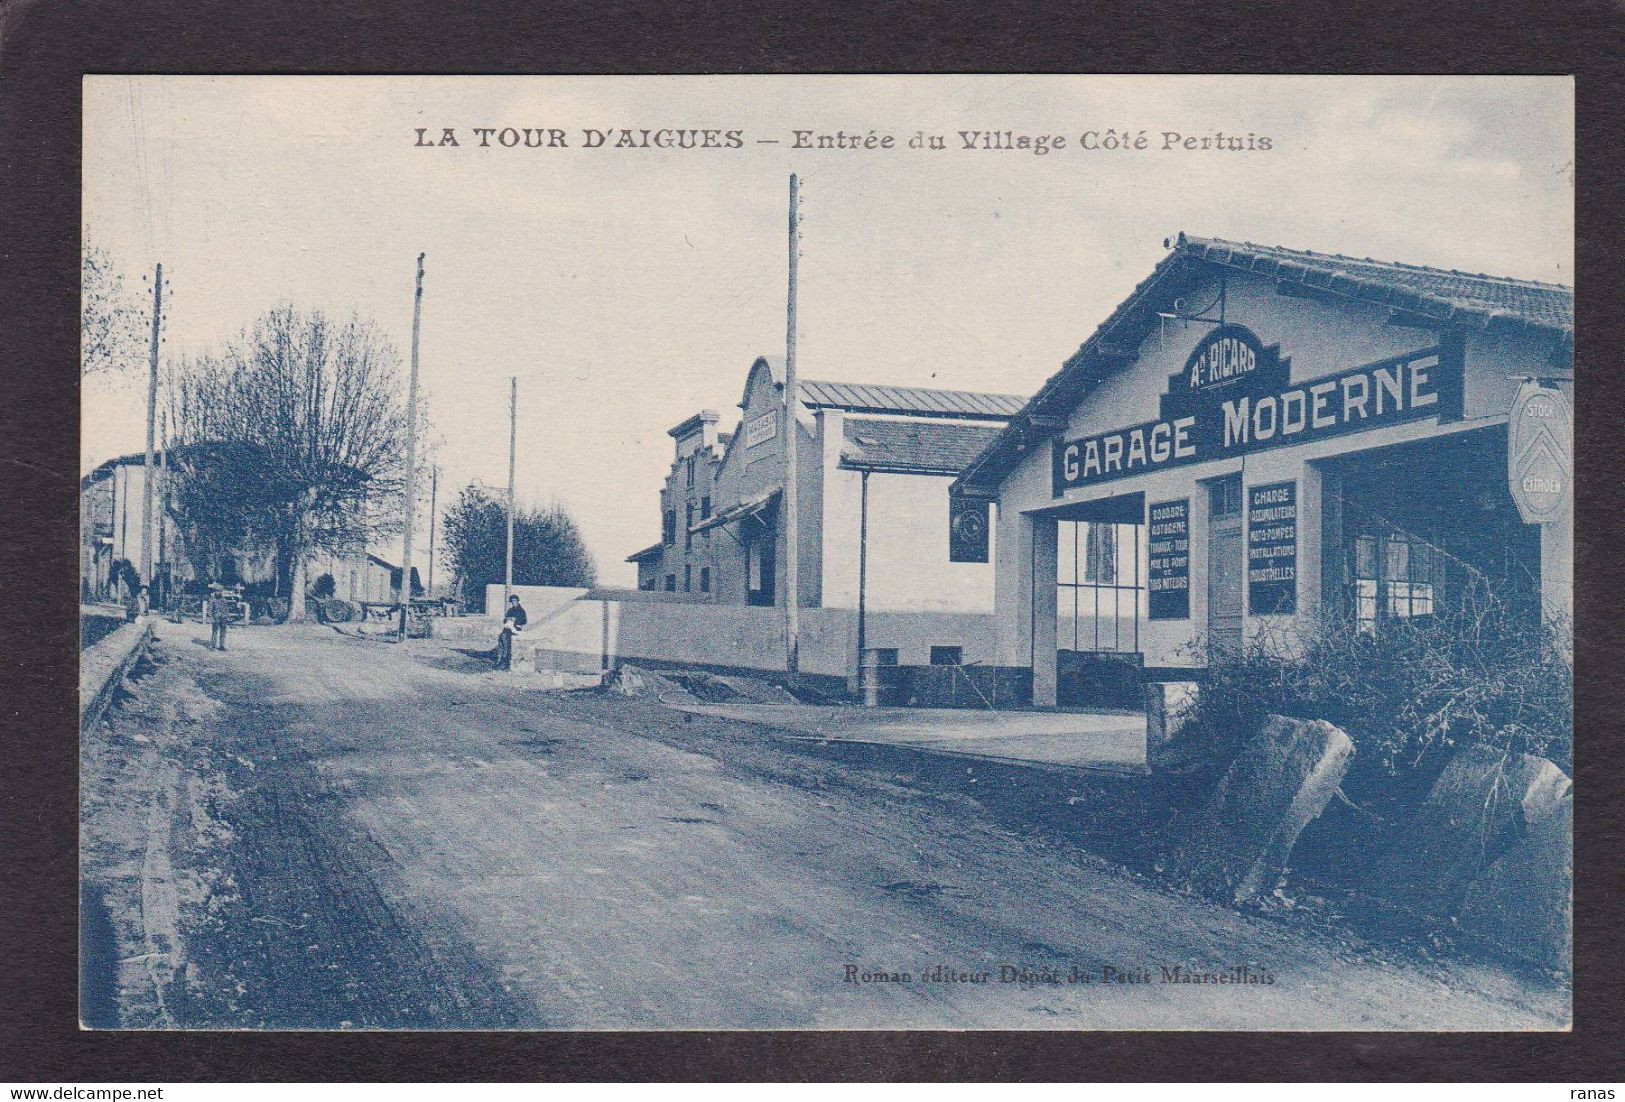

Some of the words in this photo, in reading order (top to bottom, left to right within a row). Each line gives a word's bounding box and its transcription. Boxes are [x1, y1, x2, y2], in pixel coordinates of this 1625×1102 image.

[1209, 338, 1256, 381] RICARD
[1063, 416, 1197, 482] GARAGE
[1221, 355, 1440, 448] MODERNE
[1254, 489, 1289, 505] CHARGE
